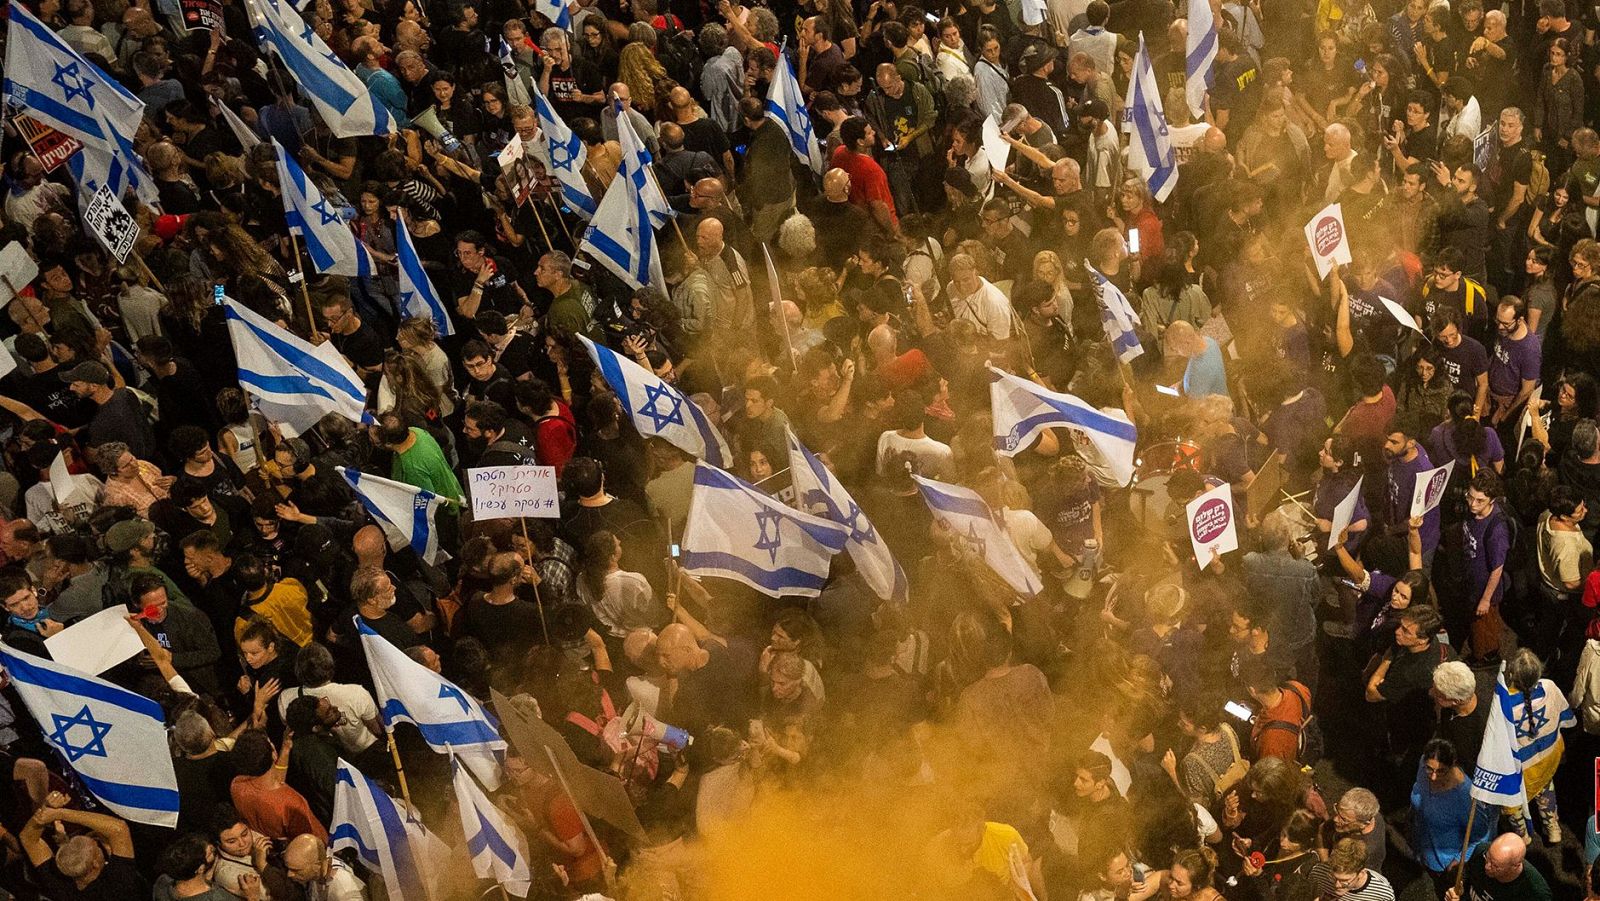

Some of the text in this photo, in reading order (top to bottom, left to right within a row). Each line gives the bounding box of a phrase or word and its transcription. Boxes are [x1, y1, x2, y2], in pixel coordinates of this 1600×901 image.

[42, 138, 79, 167] עכשיו!
[474, 469, 549, 483] אורית חטפת
[489, 482, 531, 497] סטרוק?
[475, 498, 507, 512] עכשיו!
